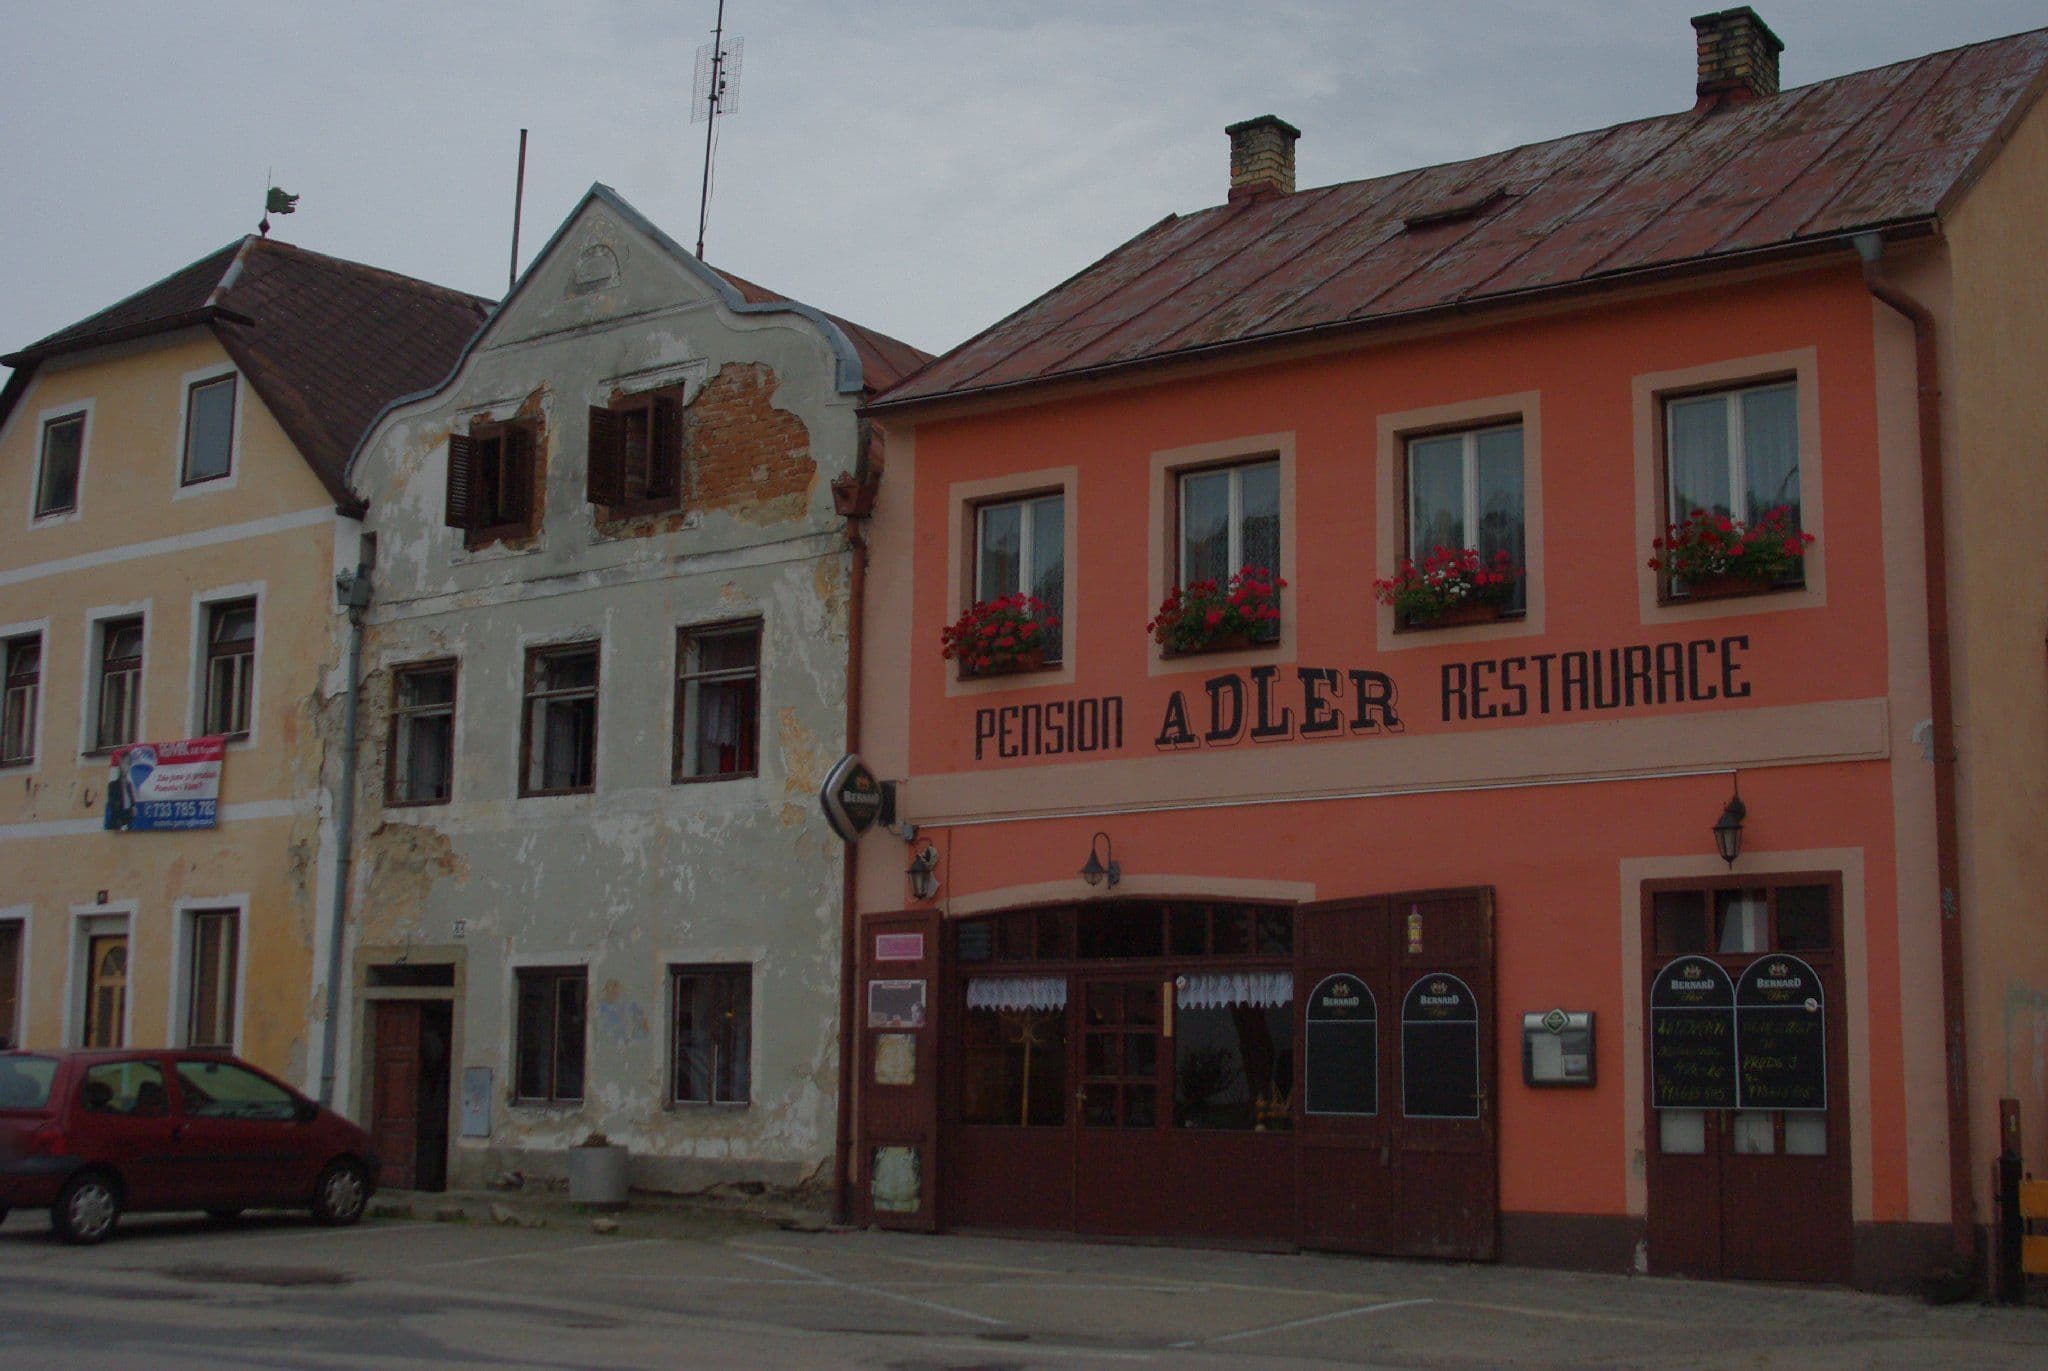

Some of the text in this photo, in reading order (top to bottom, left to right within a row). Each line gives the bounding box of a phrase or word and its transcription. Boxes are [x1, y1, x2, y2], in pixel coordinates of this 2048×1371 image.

[975, 635, 1750, 761] PENSION ADLER RESTAURACE
[1671, 978, 1715, 990] BERNARD
[1756, 977, 1801, 989] BERNARD
[1322, 996, 1360, 1008] BERNARD
[1420, 994, 1460, 1006] BERNARD
